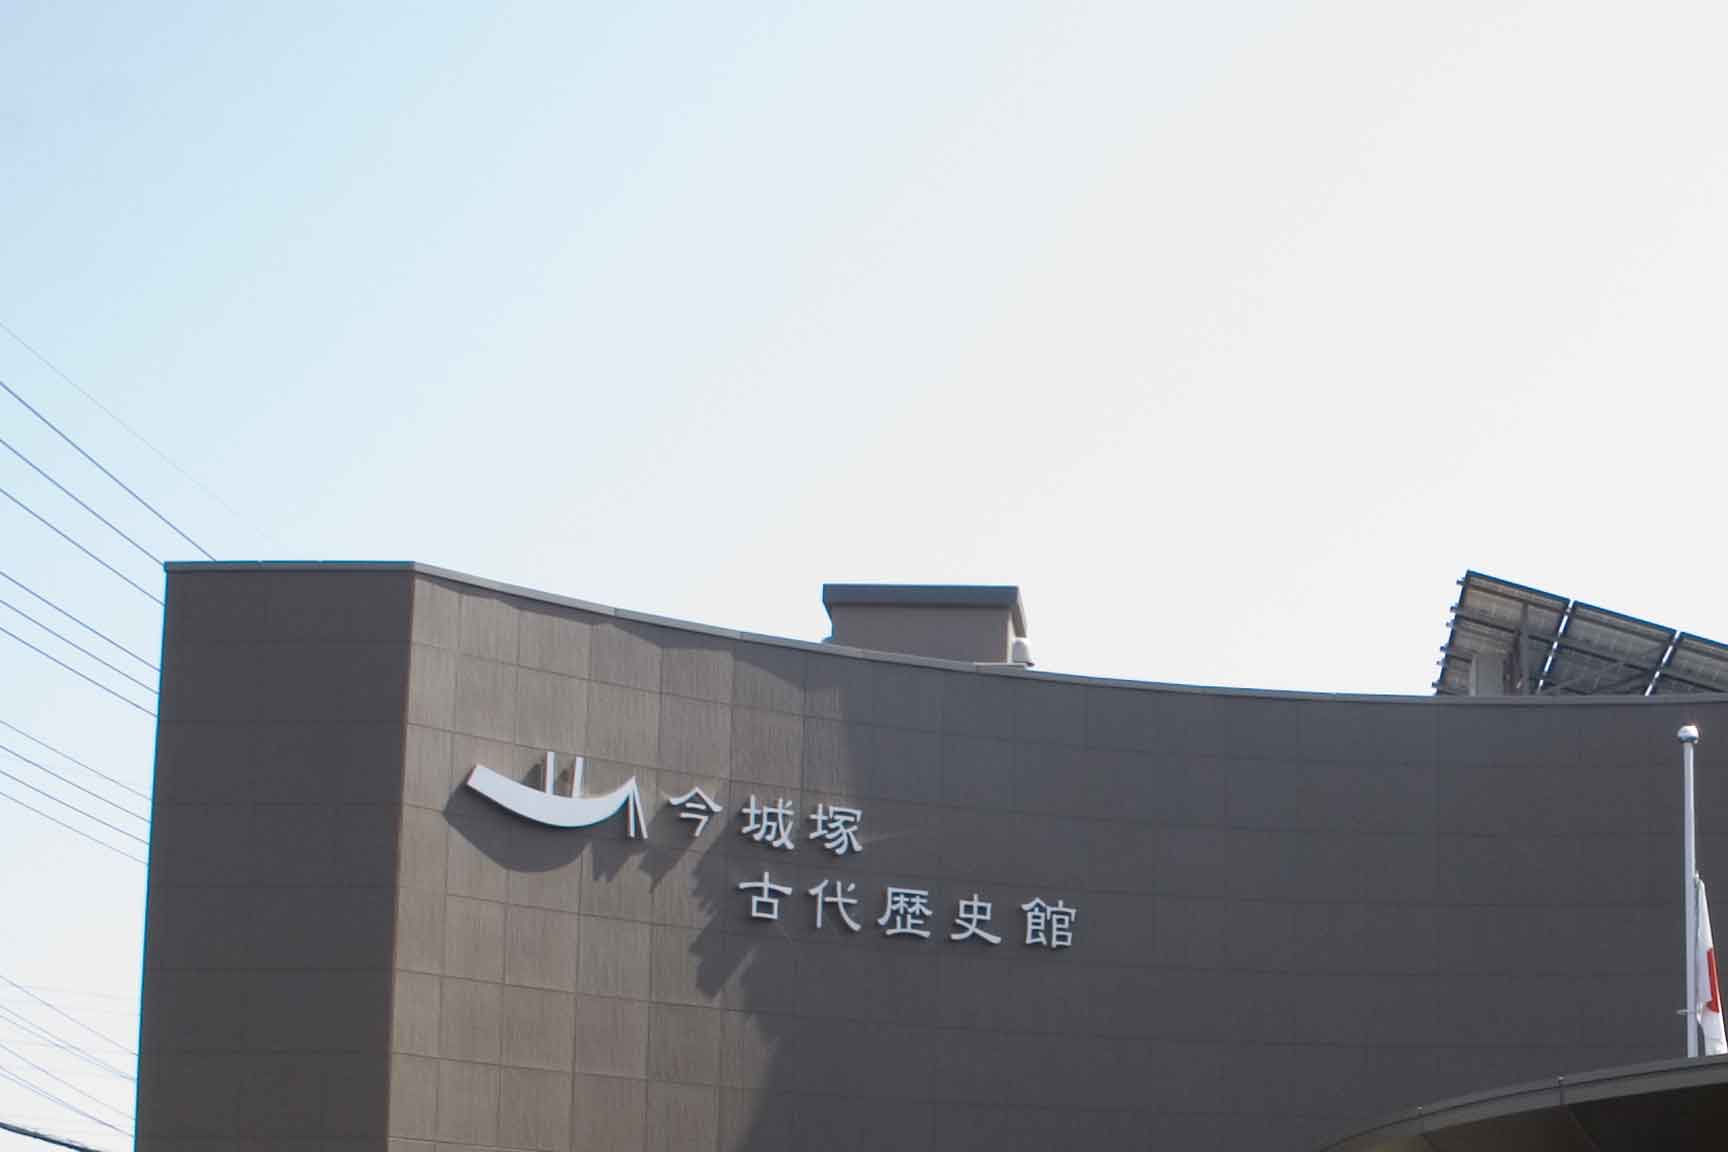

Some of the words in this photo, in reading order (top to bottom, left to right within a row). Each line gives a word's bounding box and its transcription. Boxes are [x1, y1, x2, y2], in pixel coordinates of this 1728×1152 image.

[669, 786, 863, 855] 今城塚
[738, 871, 1077, 949] 古代歴史館
